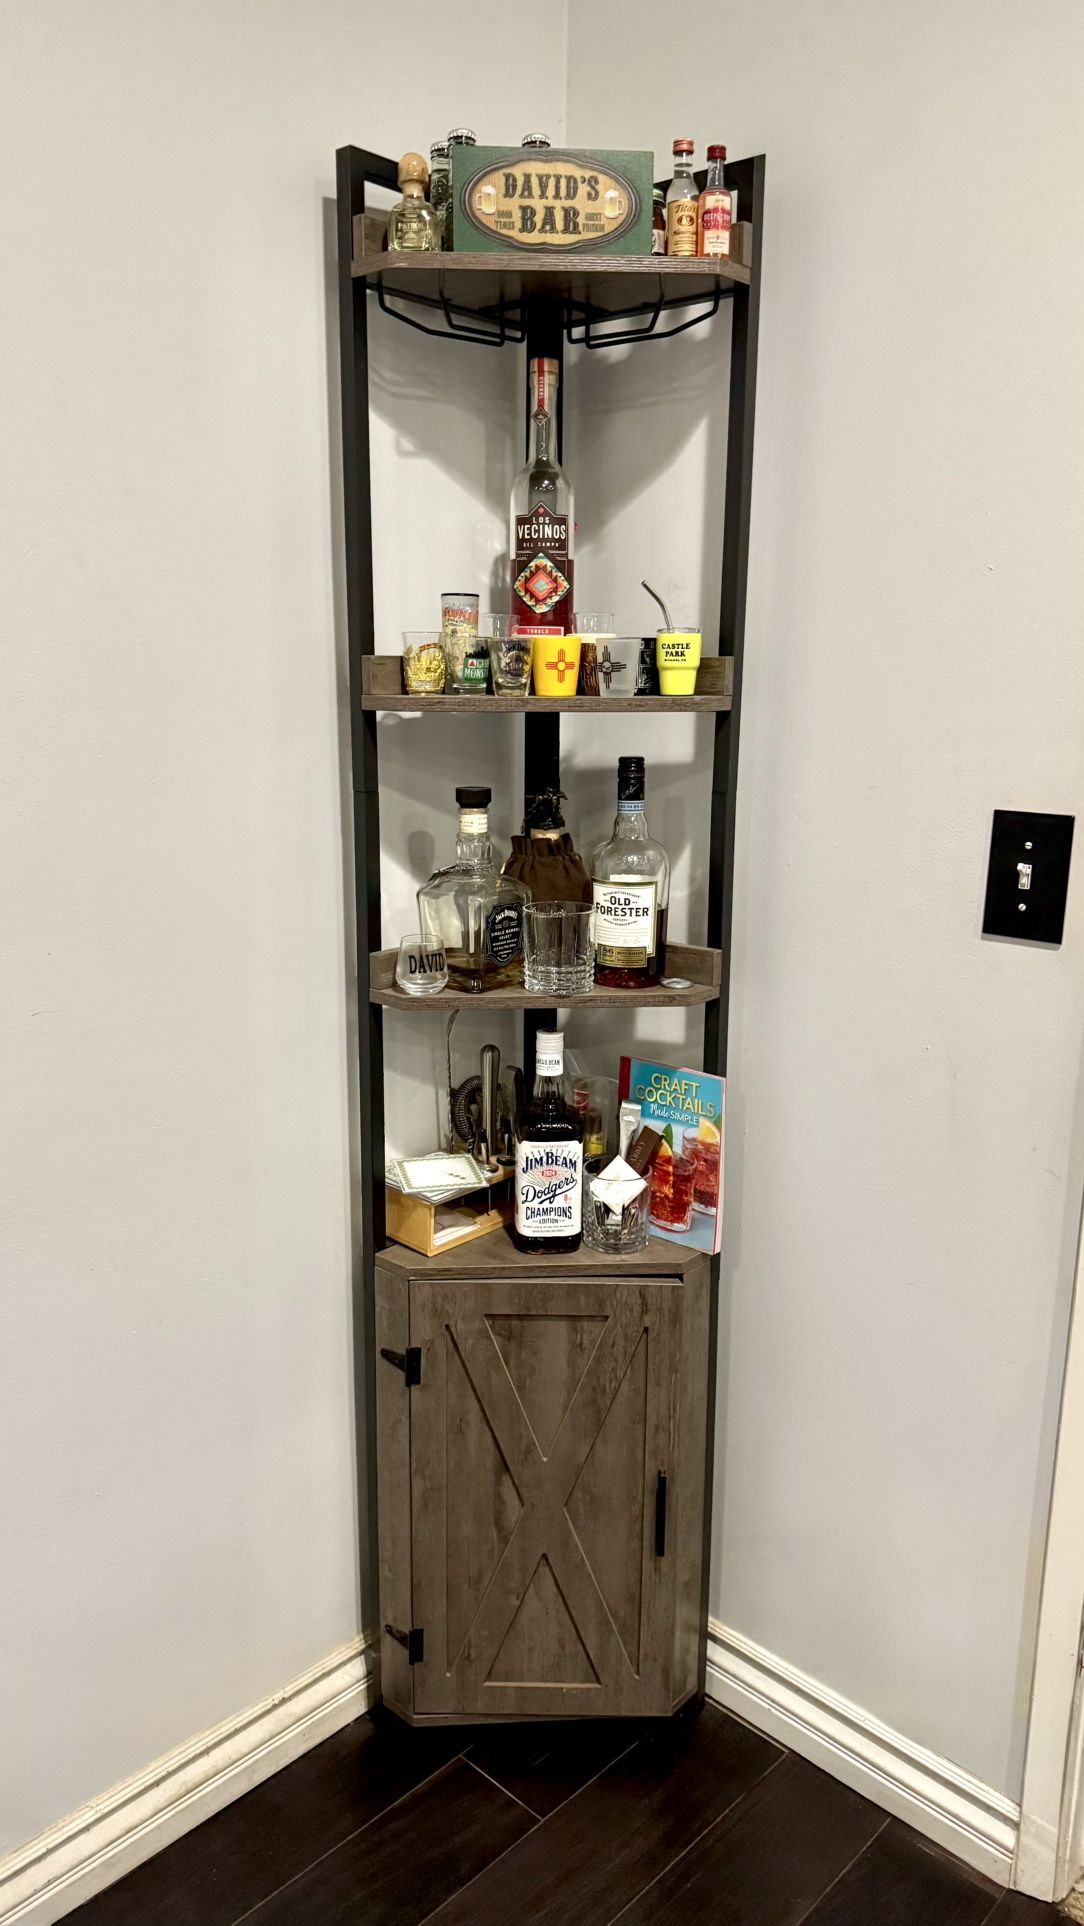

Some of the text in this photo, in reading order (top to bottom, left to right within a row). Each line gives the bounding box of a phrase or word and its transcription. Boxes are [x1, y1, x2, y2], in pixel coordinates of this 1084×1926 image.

[503, 172, 600, 201] DAVID'S
[518, 205, 581, 234] BAR
[517, 524, 566, 539] VECINOS
[595, 902, 650, 917] FORESTER
[610, 896, 631, 906] OLD
[408, 952, 445, 975] DAVID
[651, 1072, 700, 1098] CRAFT
[635, 1085, 715, 1118] COCKTAILS
[650, 1103, 699, 1126] Made SIMPLE
[522, 1151, 577, 1174] JIM BEAM
[521, 1173, 577, 1204] Dodgers
[525, 1206, 572, 1221] CHAMPIONS
[539, 1217, 559, 1225] EDITION
